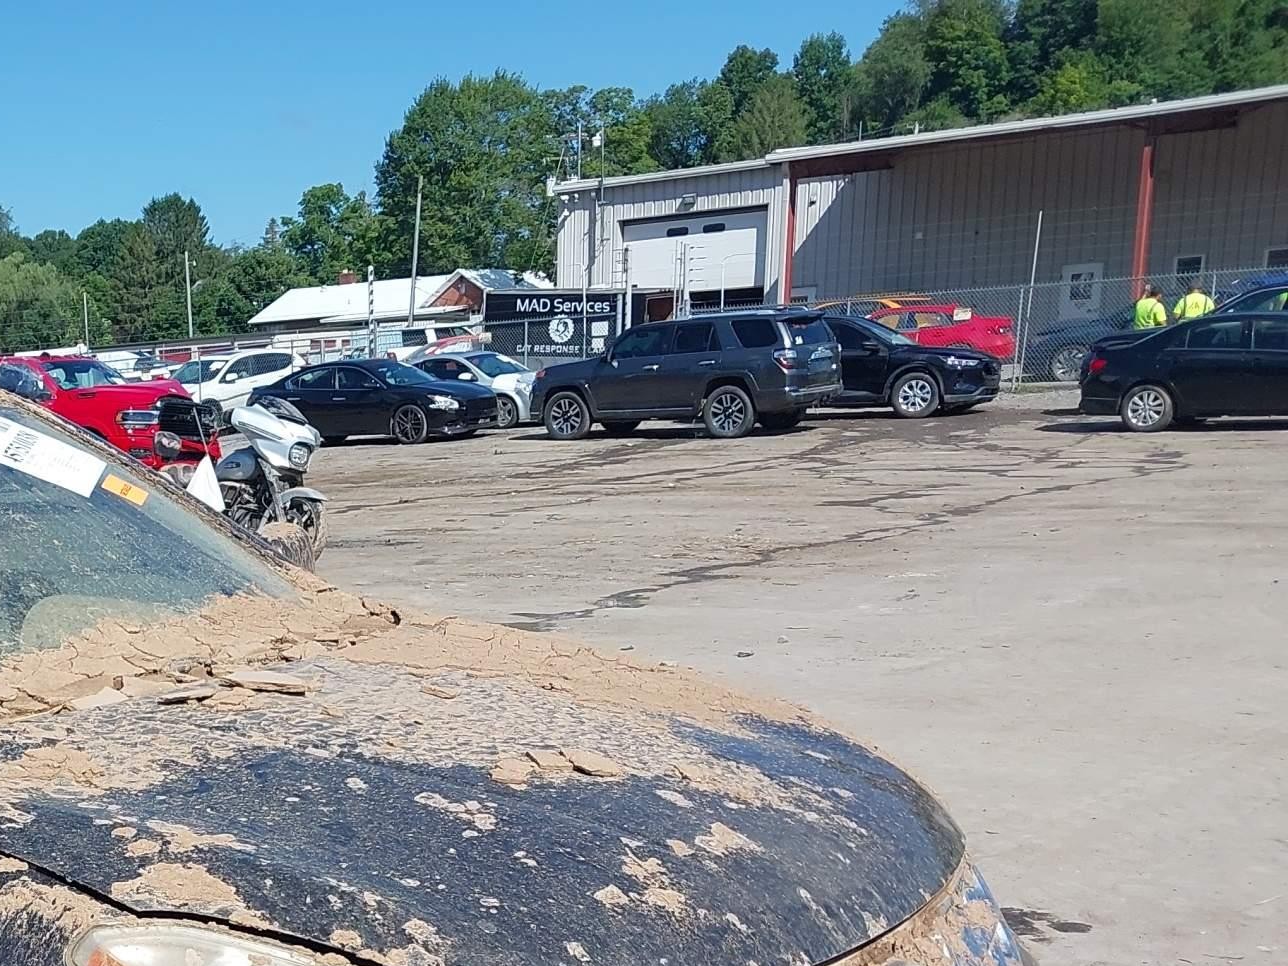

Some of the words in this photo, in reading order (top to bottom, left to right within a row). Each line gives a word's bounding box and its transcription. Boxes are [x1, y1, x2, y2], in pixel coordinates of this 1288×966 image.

[516, 298, 550, 313] MAD
[553, 298, 610, 313] Servces
[533, 344, 580, 354] RESPONSE
